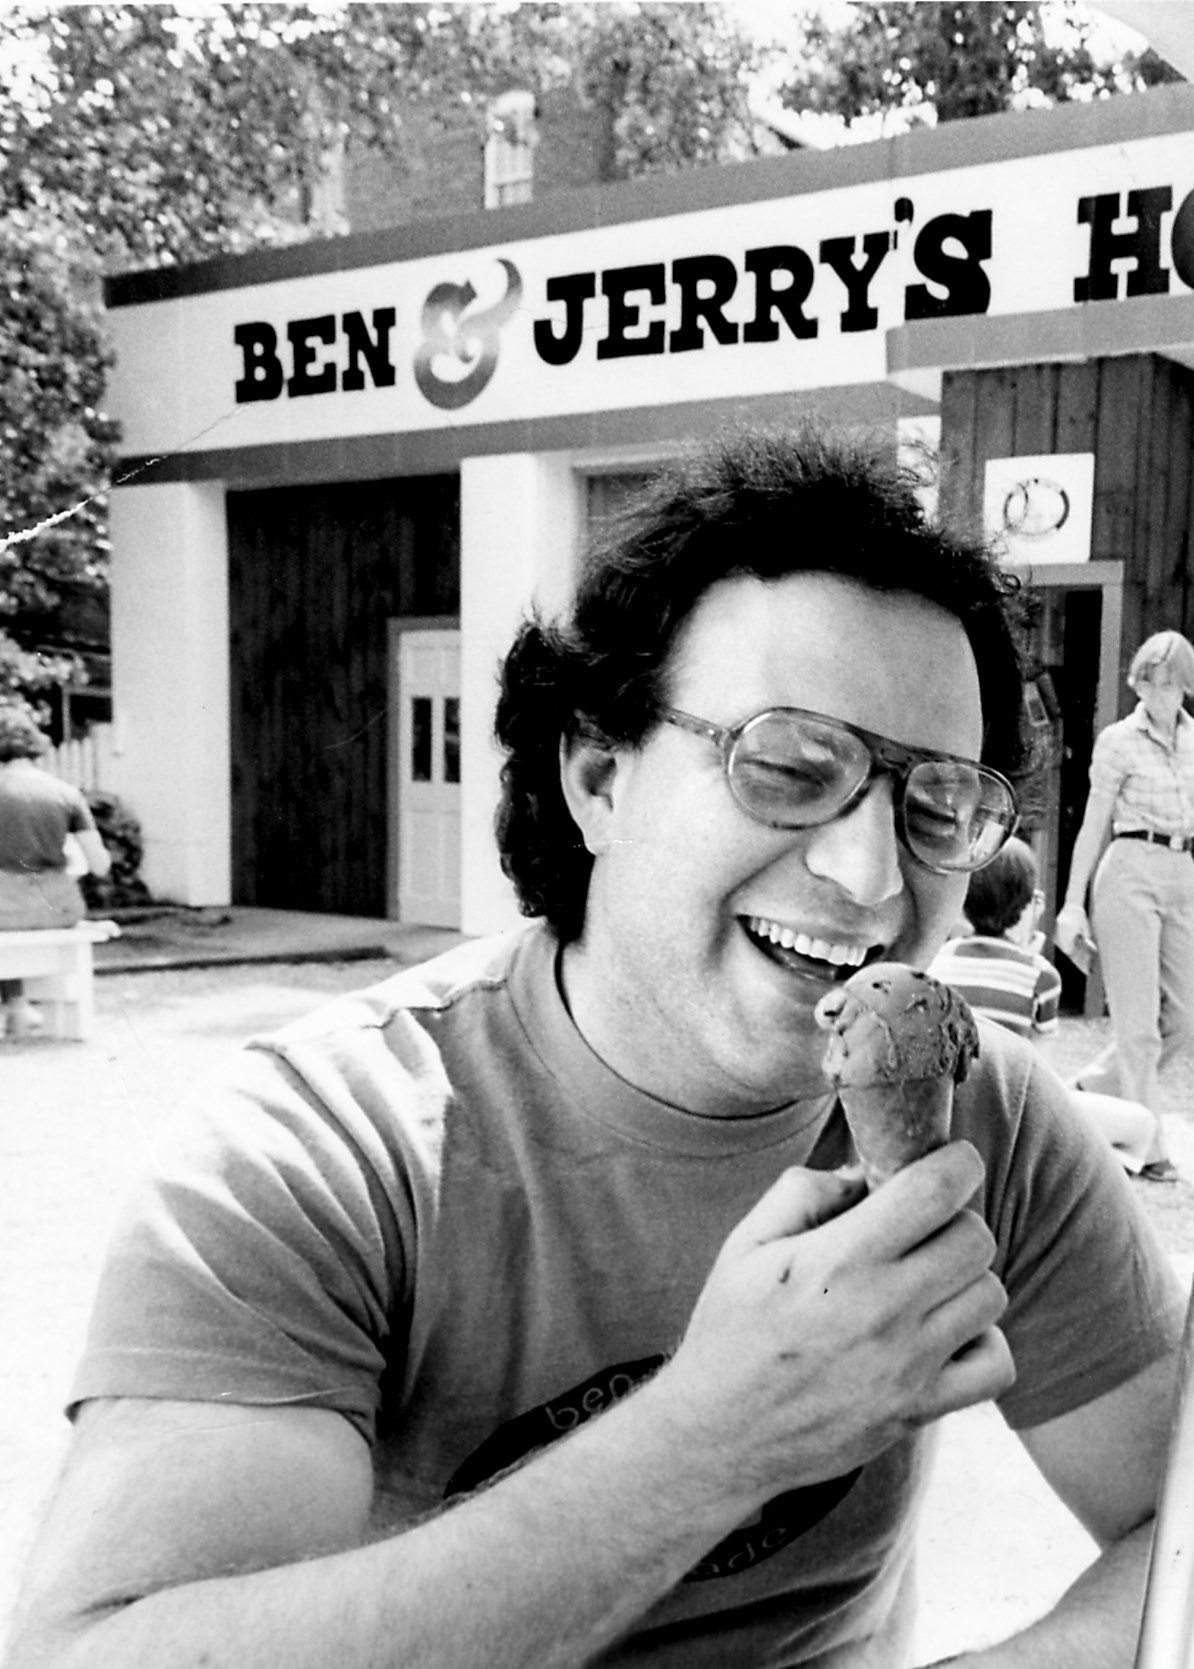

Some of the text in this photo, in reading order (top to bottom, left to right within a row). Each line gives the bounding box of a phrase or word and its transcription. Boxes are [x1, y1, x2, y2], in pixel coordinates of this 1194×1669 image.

[234, 307, 397, 405] BEN
[413, 257, 525, 412] &
[533, 197, 993, 366] JERRY'S
